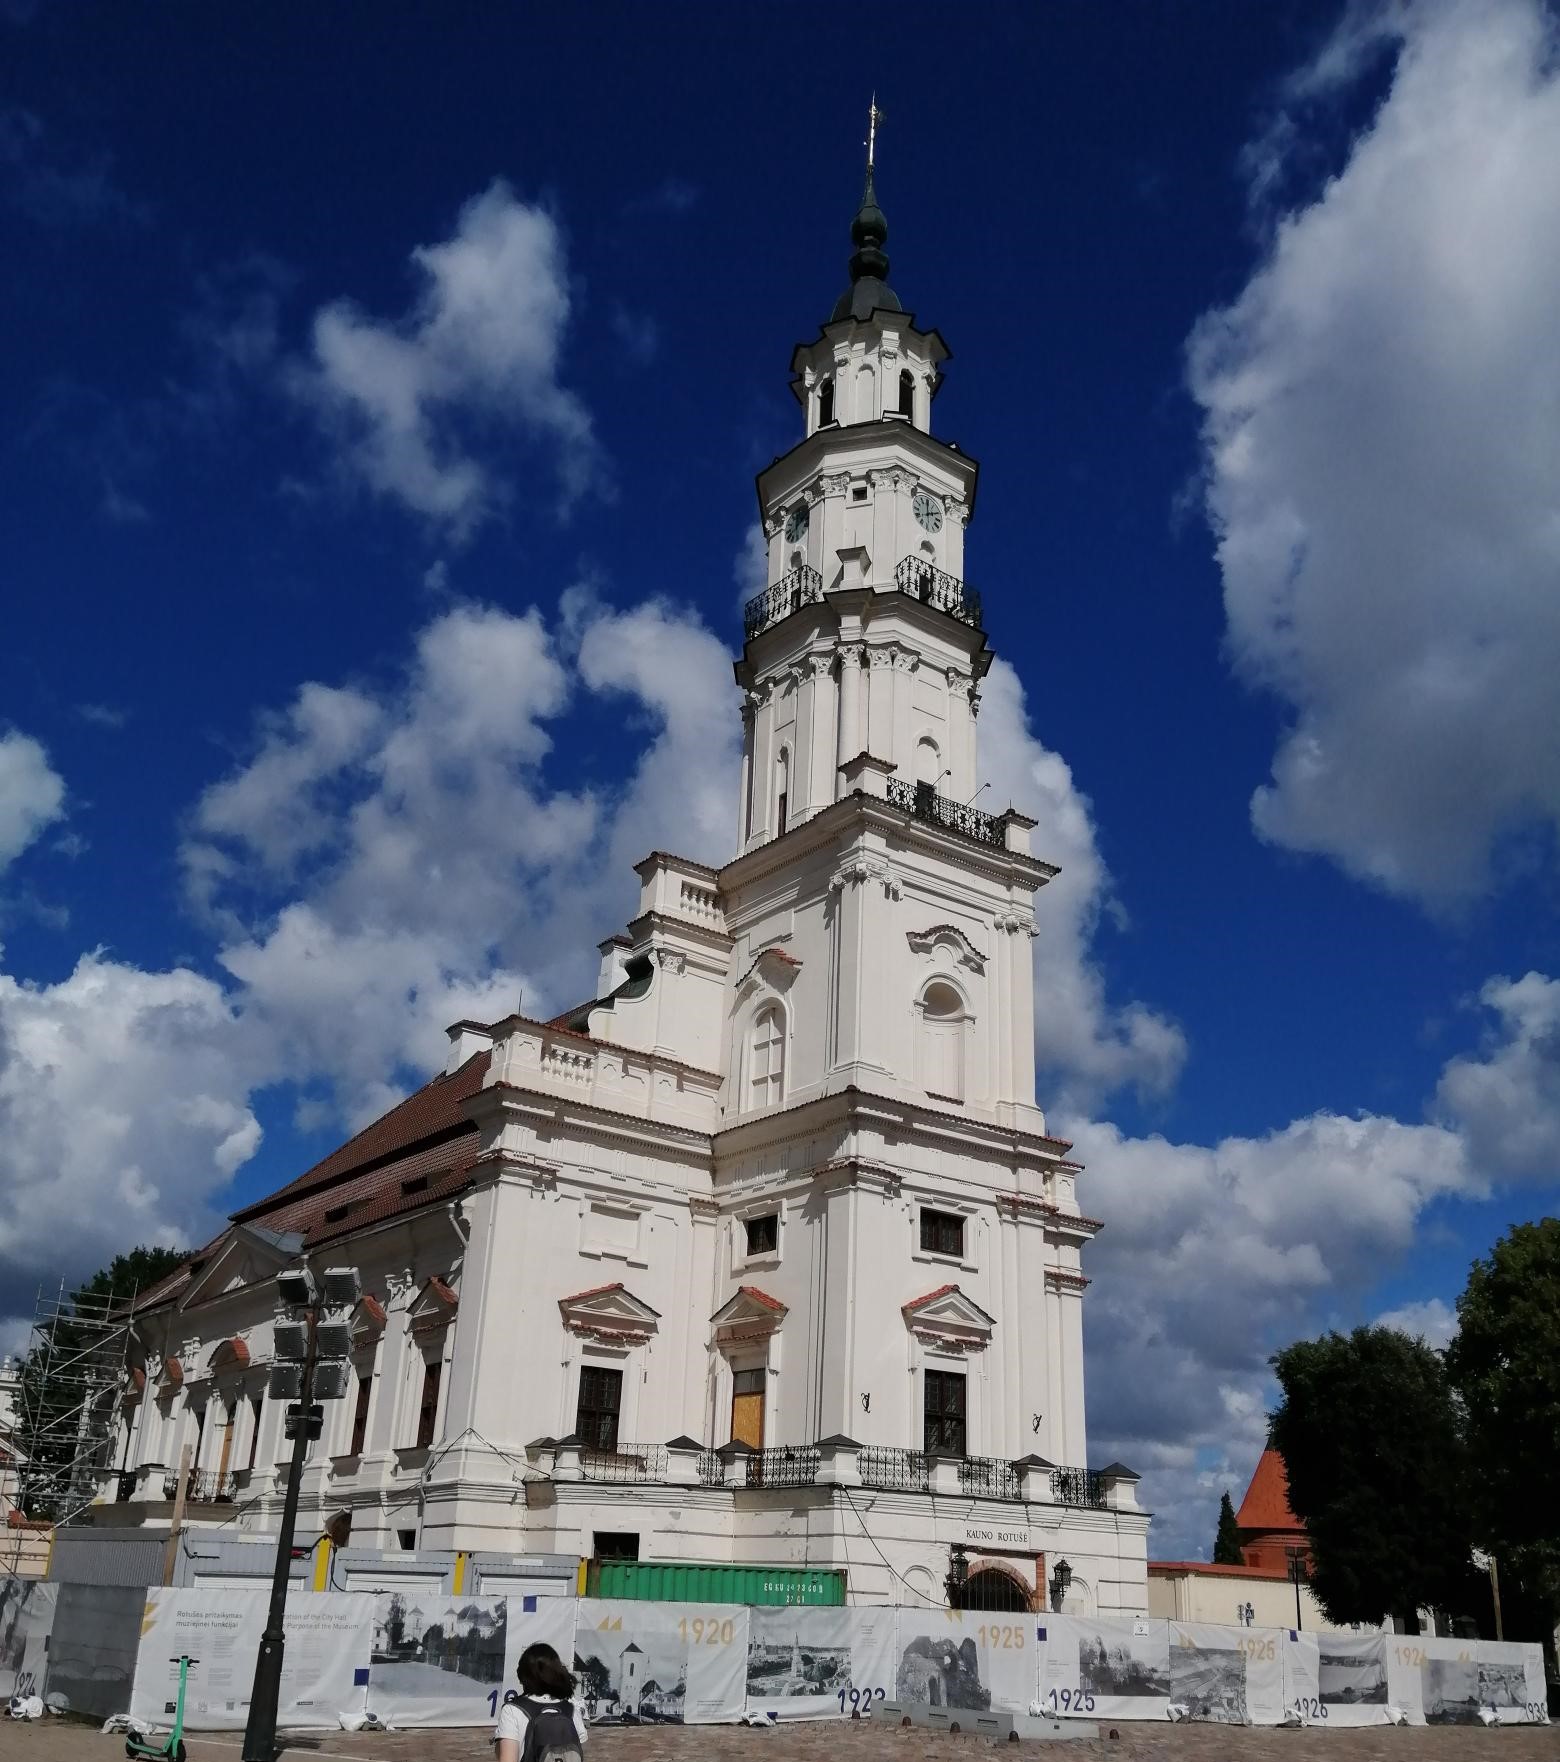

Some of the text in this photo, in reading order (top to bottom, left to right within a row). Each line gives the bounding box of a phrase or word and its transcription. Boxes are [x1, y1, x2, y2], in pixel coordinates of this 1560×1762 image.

[966, 1529, 993, 1540] KAUNO
[678, 1617, 734, 1645] 1920
[978, 1625, 1025, 1649] 1925
[1237, 1638, 1275, 1661] 1925
[1049, 1688, 1095, 1712] 1925
[1294, 1697, 1328, 1719] 1926
